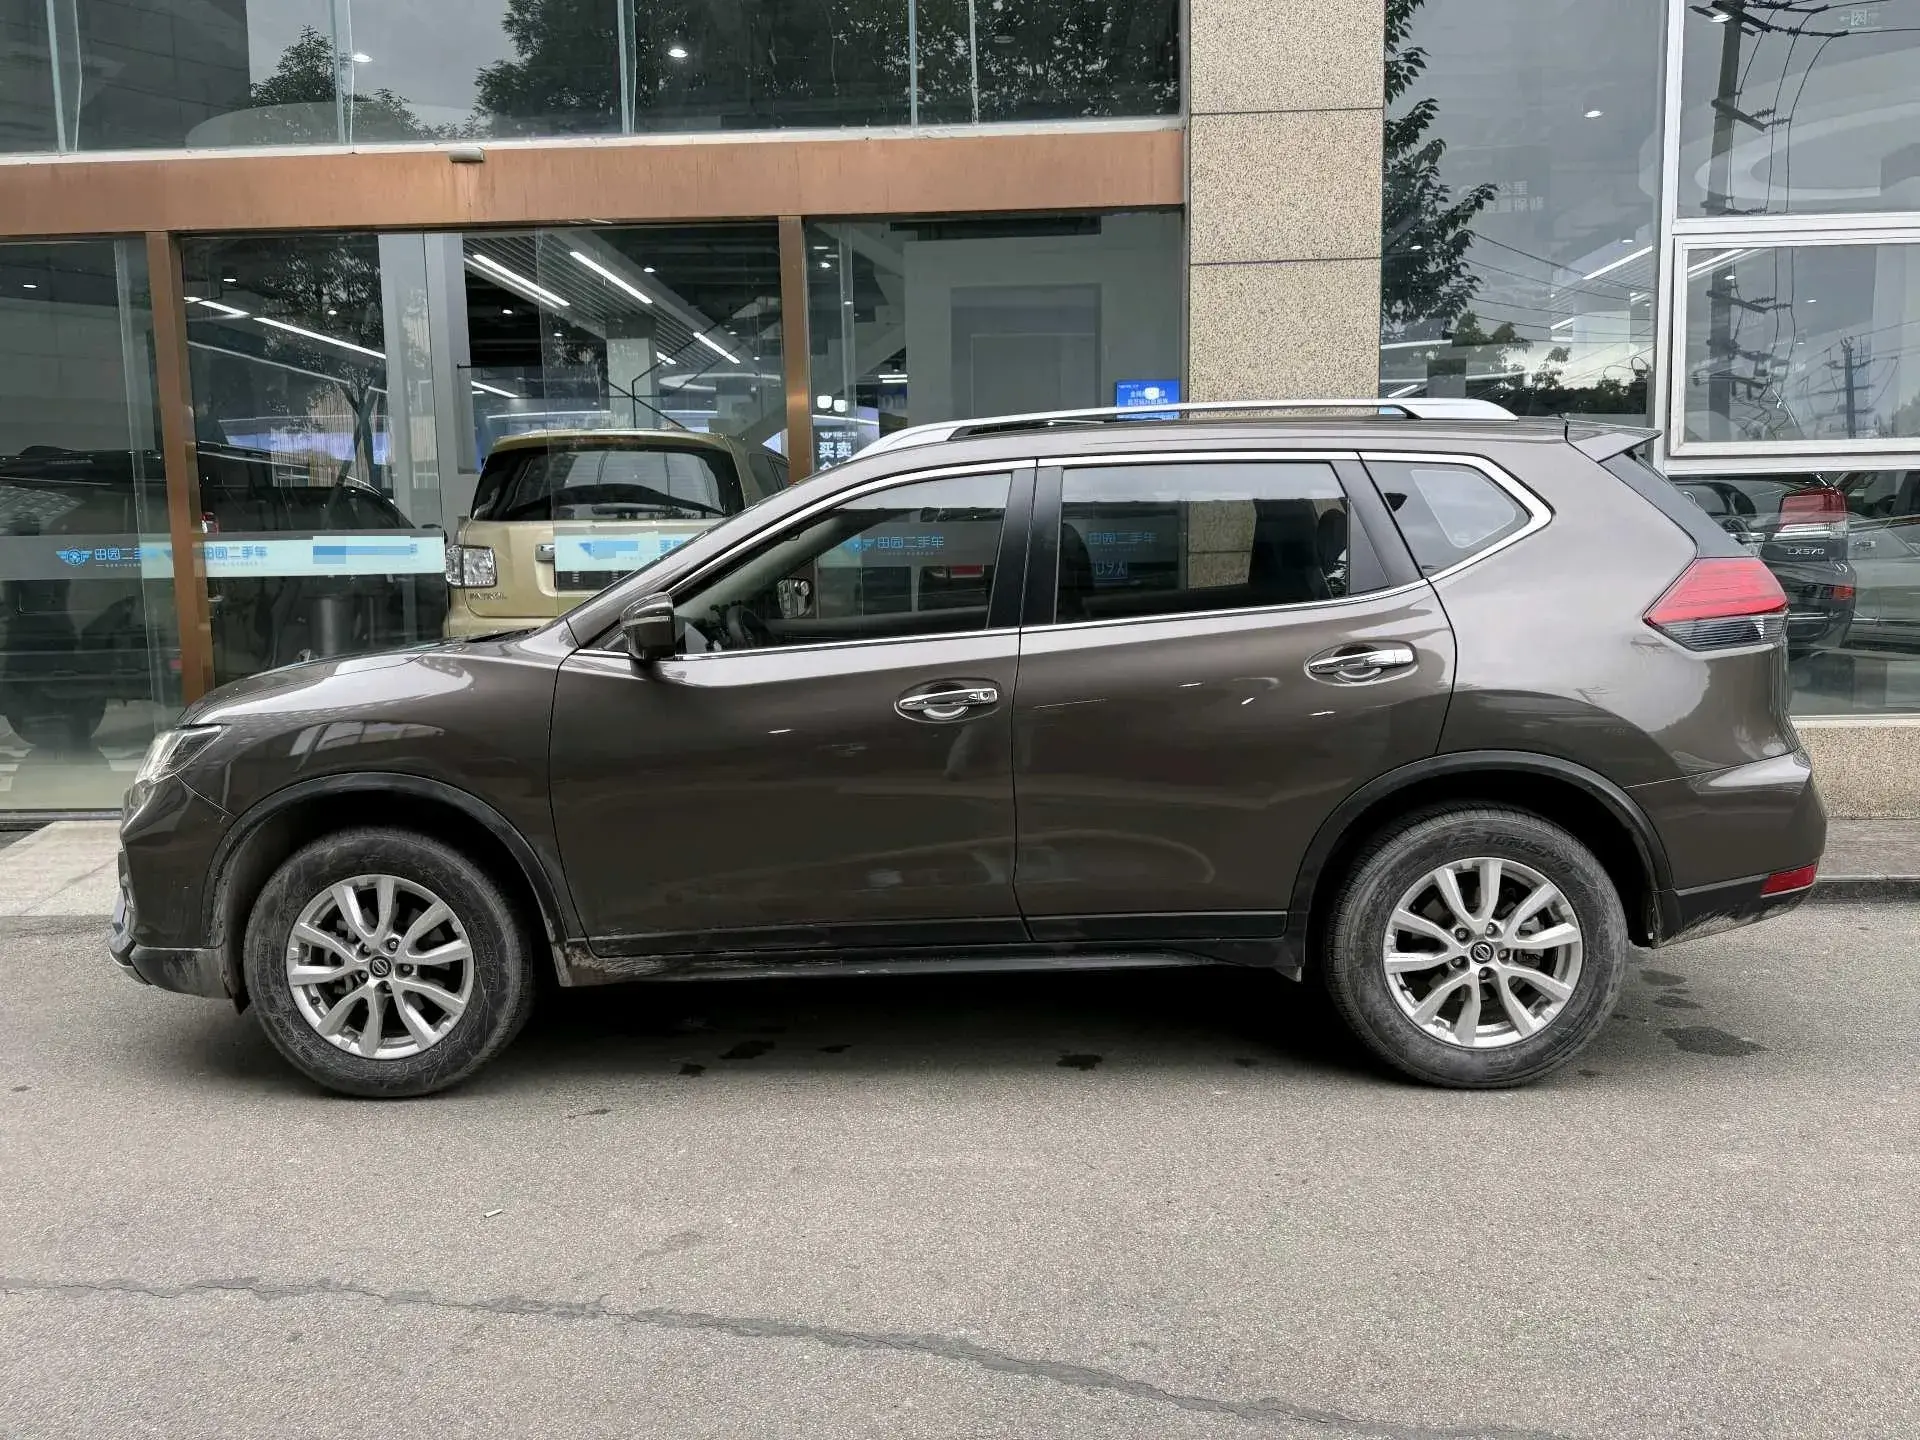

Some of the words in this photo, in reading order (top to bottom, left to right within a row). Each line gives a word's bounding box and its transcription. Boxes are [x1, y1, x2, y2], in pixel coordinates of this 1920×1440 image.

[878, 535, 944, 549] 田园二手车
[95, 548, 158, 560] 田园二手
